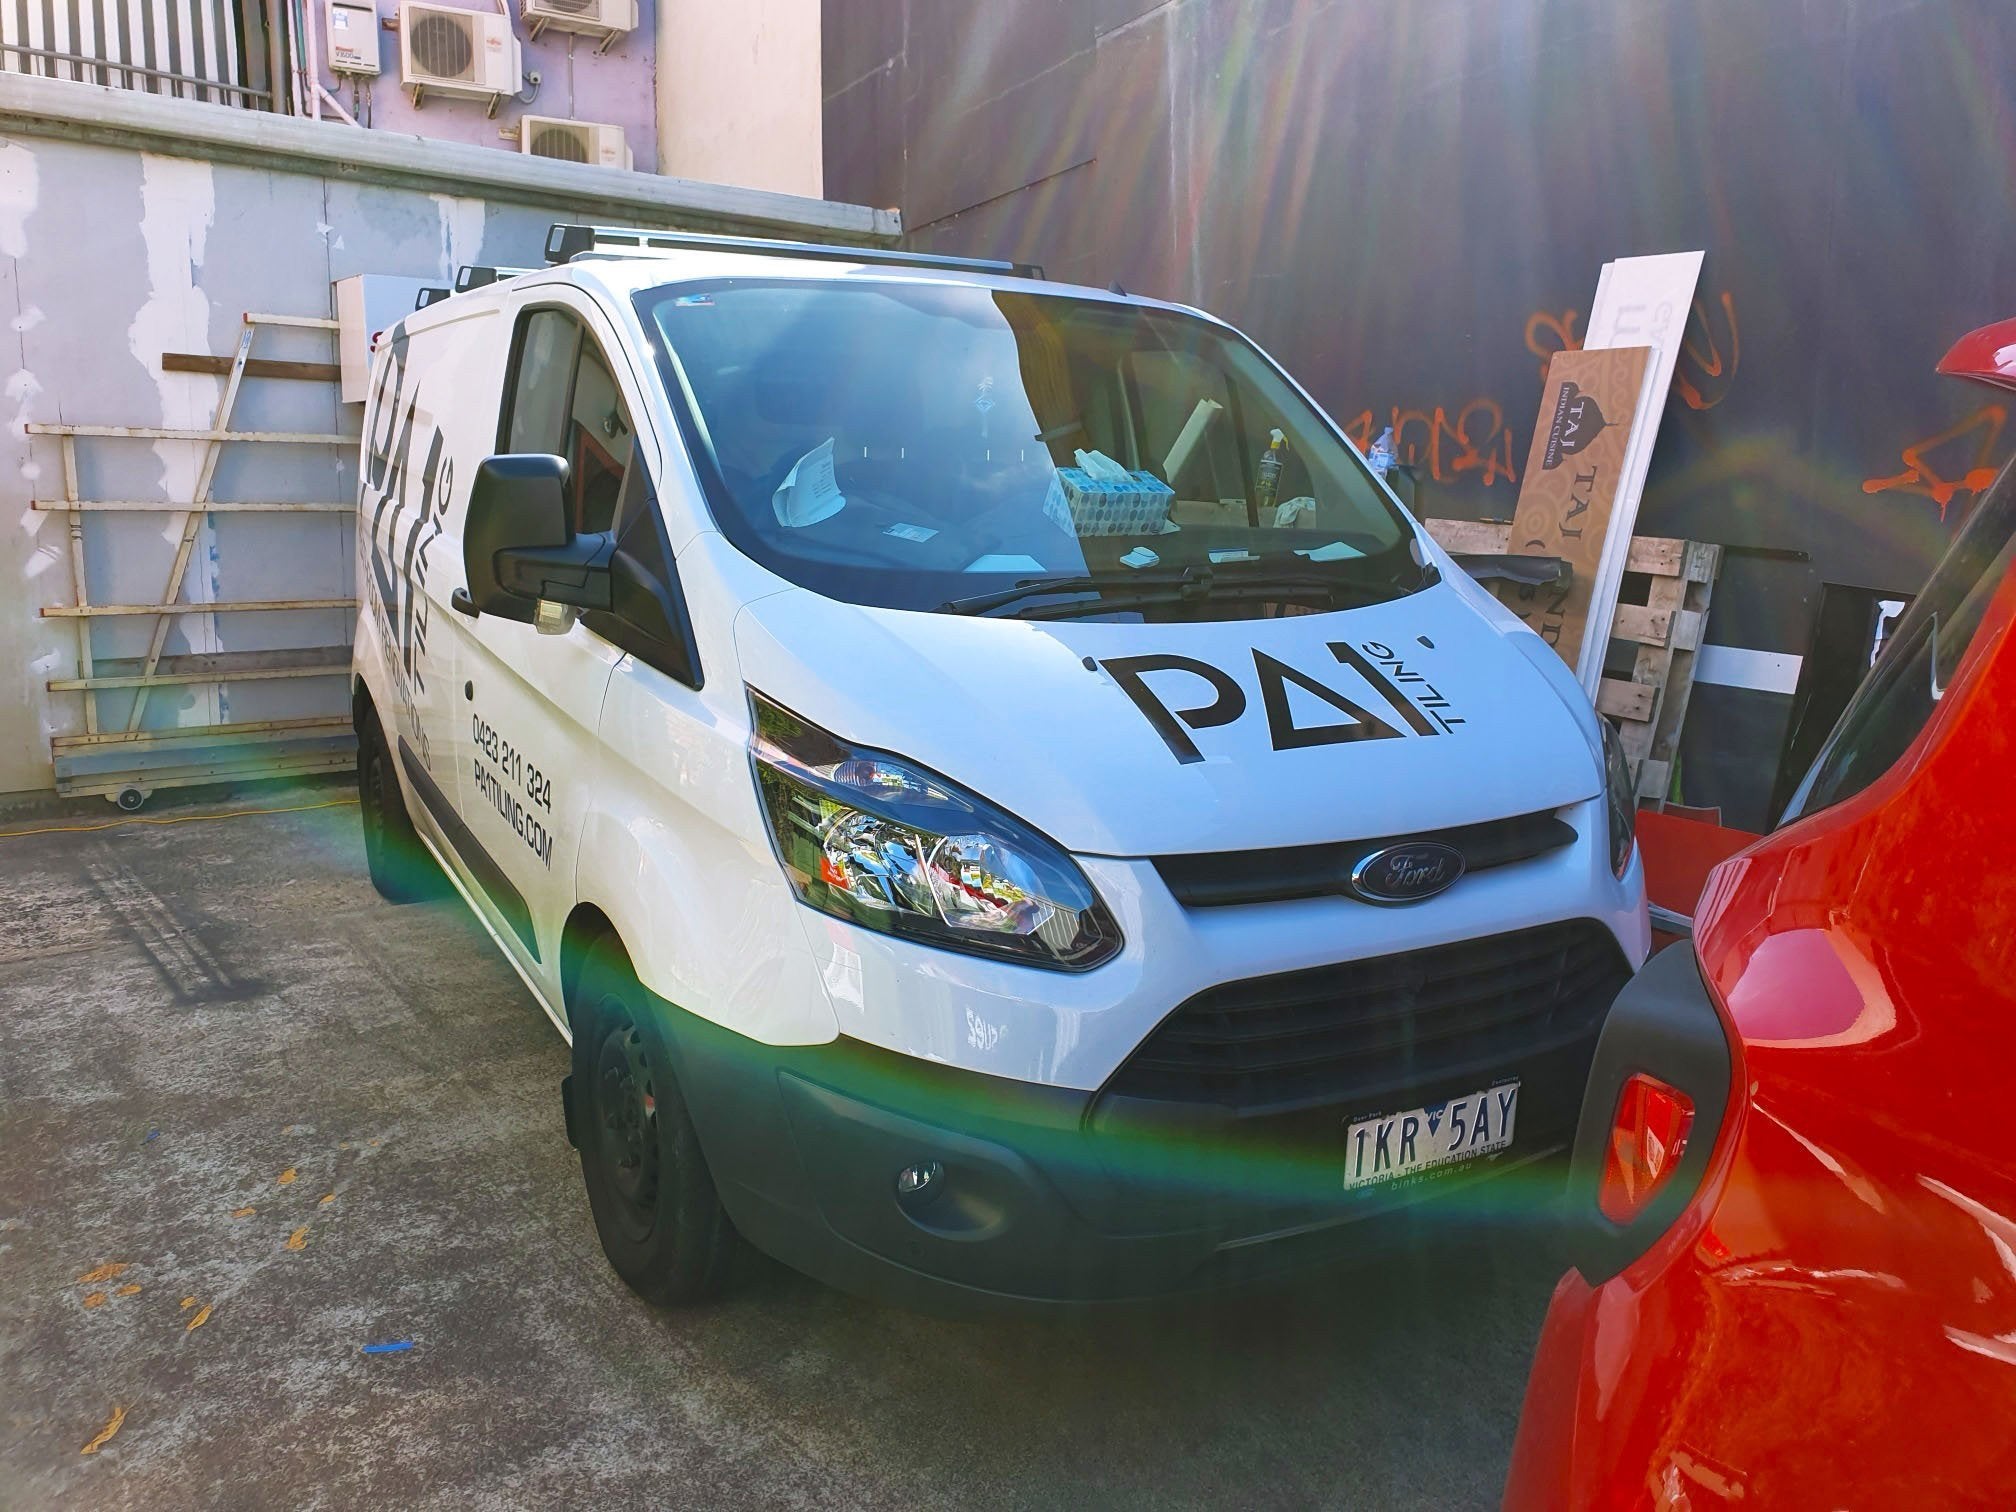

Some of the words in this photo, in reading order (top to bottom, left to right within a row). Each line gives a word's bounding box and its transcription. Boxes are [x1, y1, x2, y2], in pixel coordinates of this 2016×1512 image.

[1555, 386, 1570, 424] INDIAN
[1560, 401, 1585, 447] TAJ
[1546, 425, 1561, 466] CUISINE
[1559, 465, 1597, 541] TAJ
[413, 455, 454, 694] TILING
[1361, 640, 1466, 735] TILING
[473, 713, 499, 764] 0423
[502, 740, 521, 786] 211
[526, 763, 551, 815] 324
[474, 758, 553, 873] PA1TILING.COM
[1385, 853, 1447, 890] Ford
[1427, 1109, 1444, 1121] VIC
[1350, 1171, 1394, 1189] VICTORIA
[1404, 1163, 1423, 1177] THE
[1425, 1148, 1478, 1170] EDUCATION
[1480, 1140, 1507, 1156] STATE
